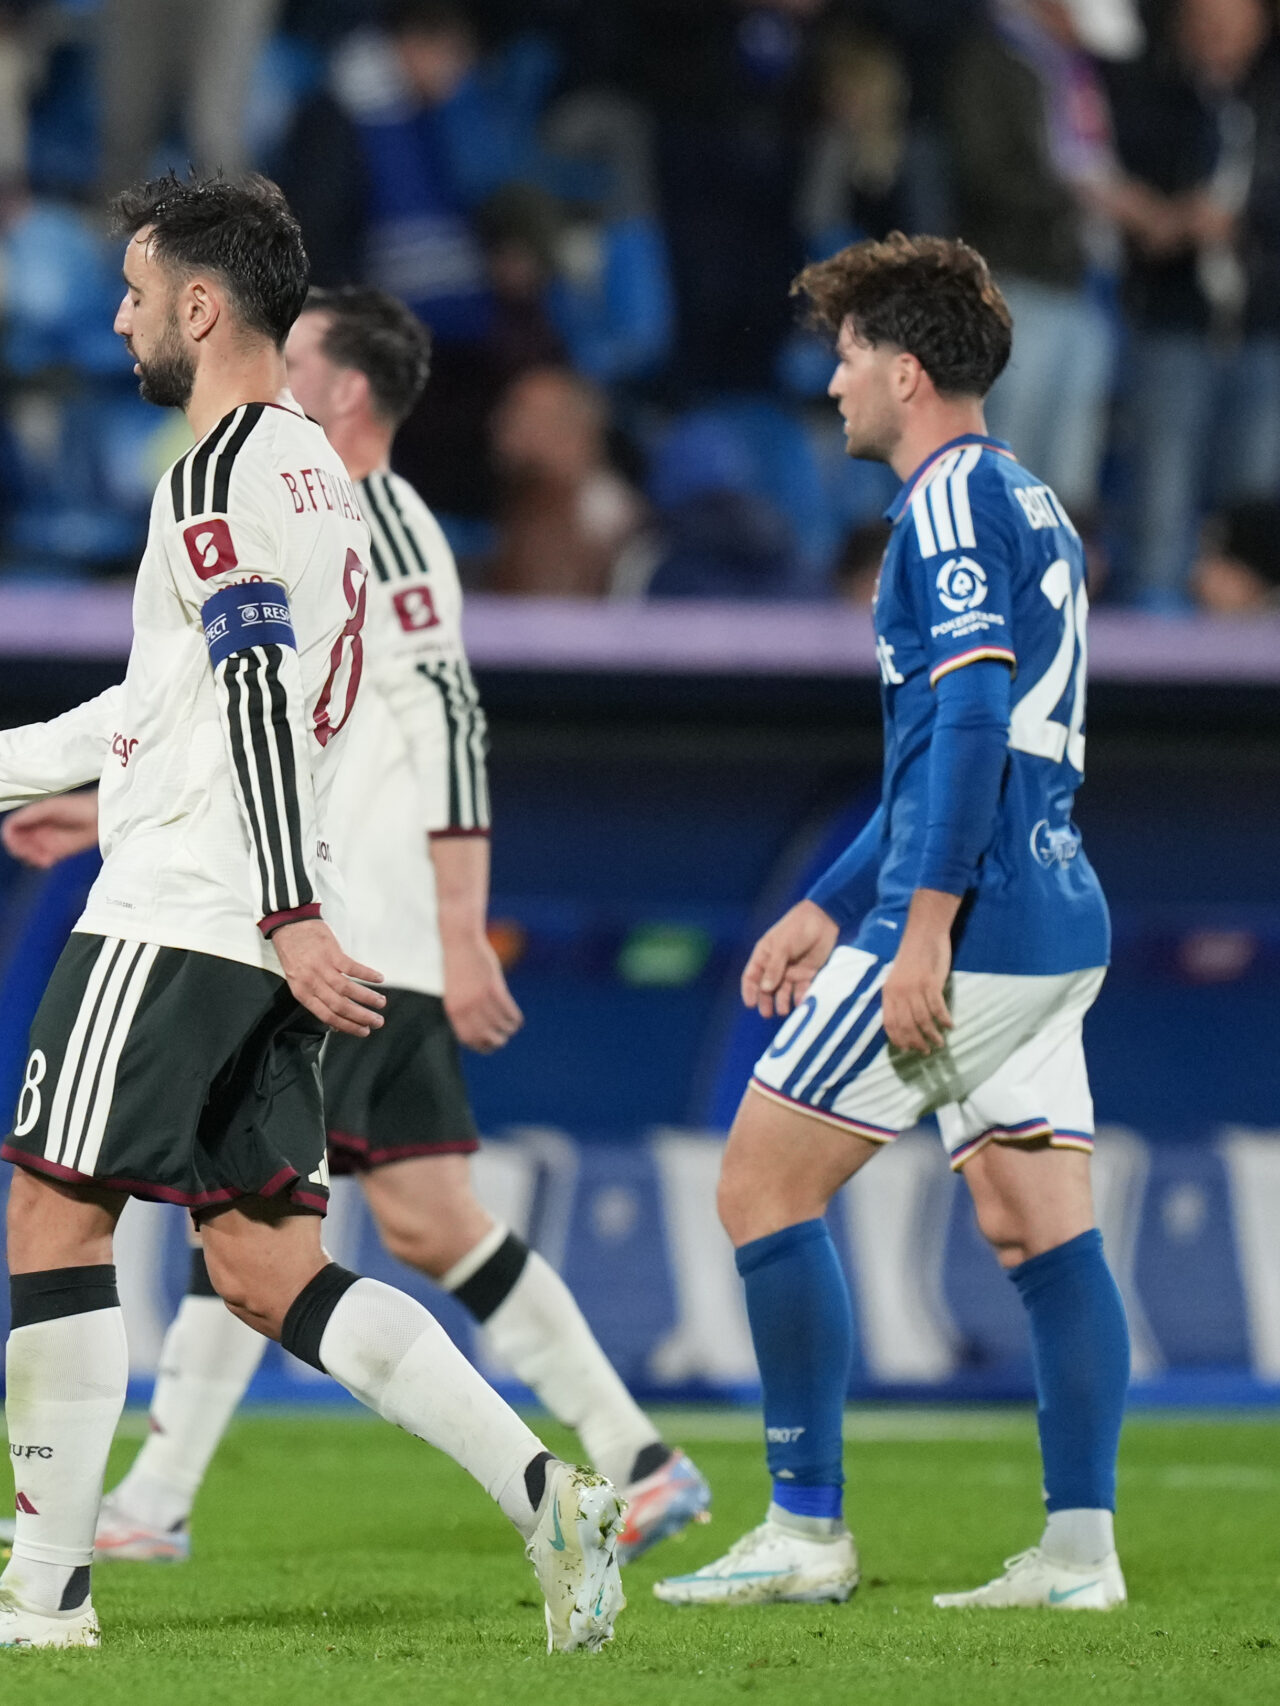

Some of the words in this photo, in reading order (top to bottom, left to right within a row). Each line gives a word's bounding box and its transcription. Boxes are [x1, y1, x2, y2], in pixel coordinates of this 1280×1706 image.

[205, 617, 227, 641] PECT
[312, 547, 369, 748] 8
[13, 1048, 47, 1137] 8
